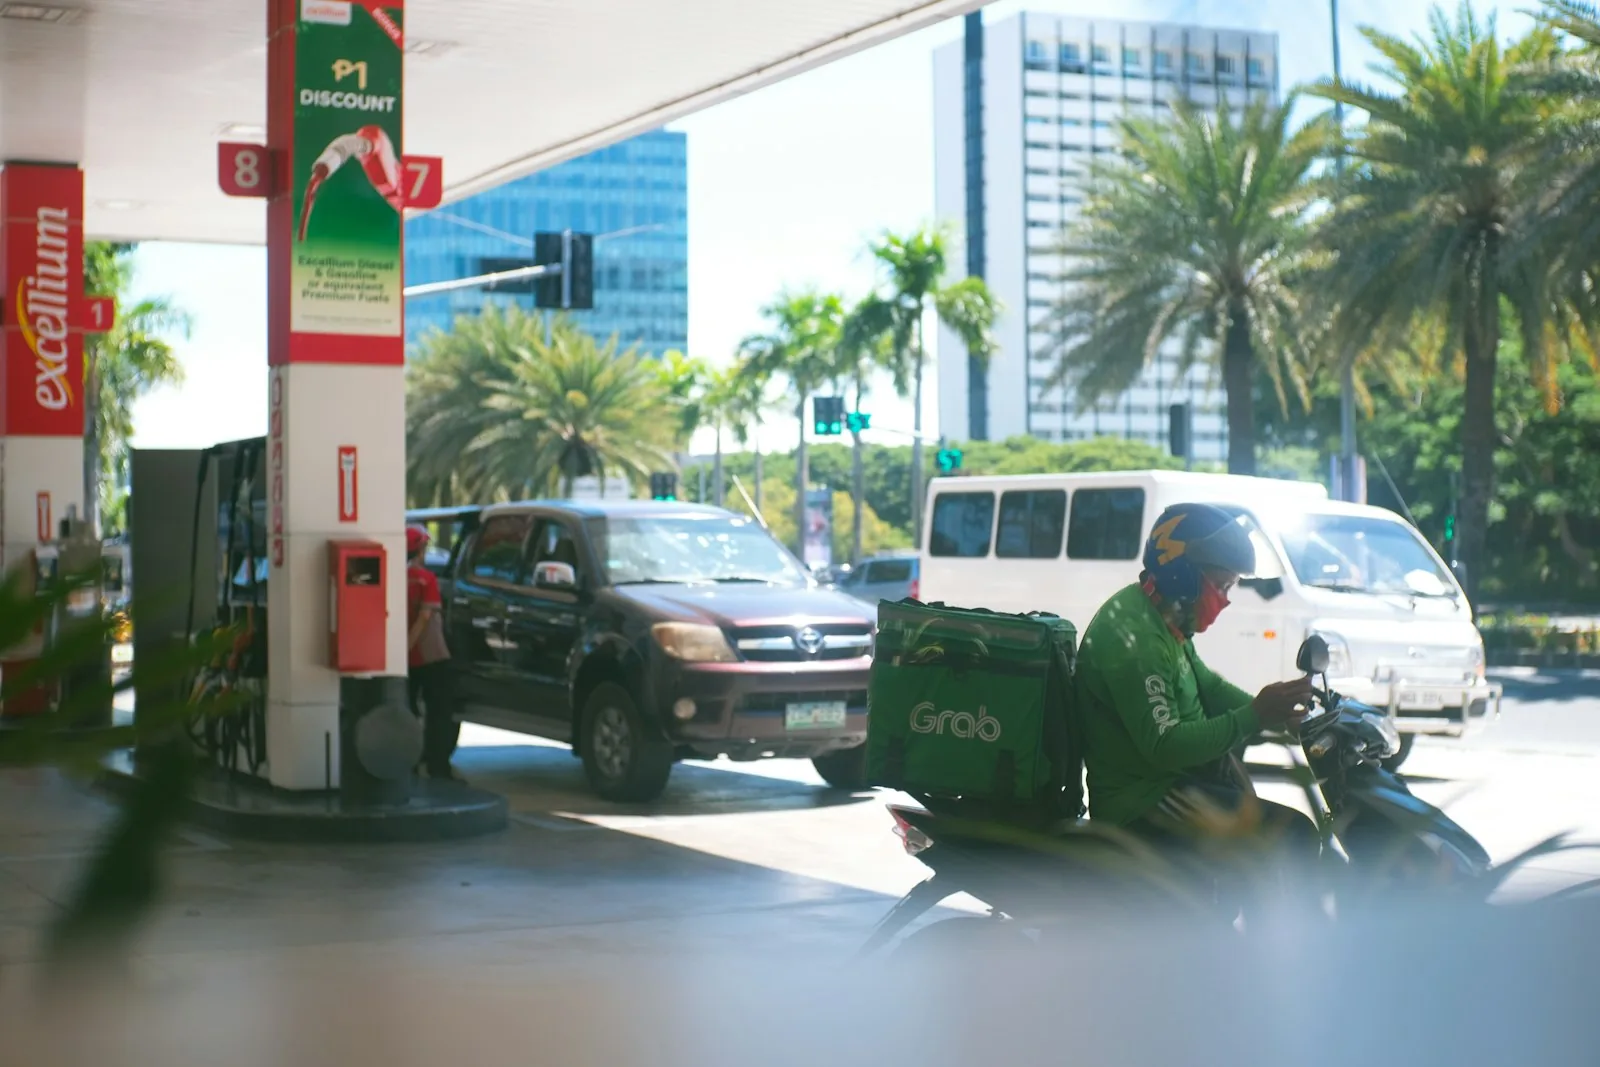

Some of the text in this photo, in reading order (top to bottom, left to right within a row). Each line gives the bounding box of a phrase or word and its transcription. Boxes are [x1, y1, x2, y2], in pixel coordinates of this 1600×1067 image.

[300, 88, 396, 113] DISCOUNT
[233, 150, 259, 189] 8
[405, 162, 430, 200] 7
[26, 206, 69, 411] excellium
[91, 302, 104, 328] 1
[909, 700, 1002, 743] Grab
